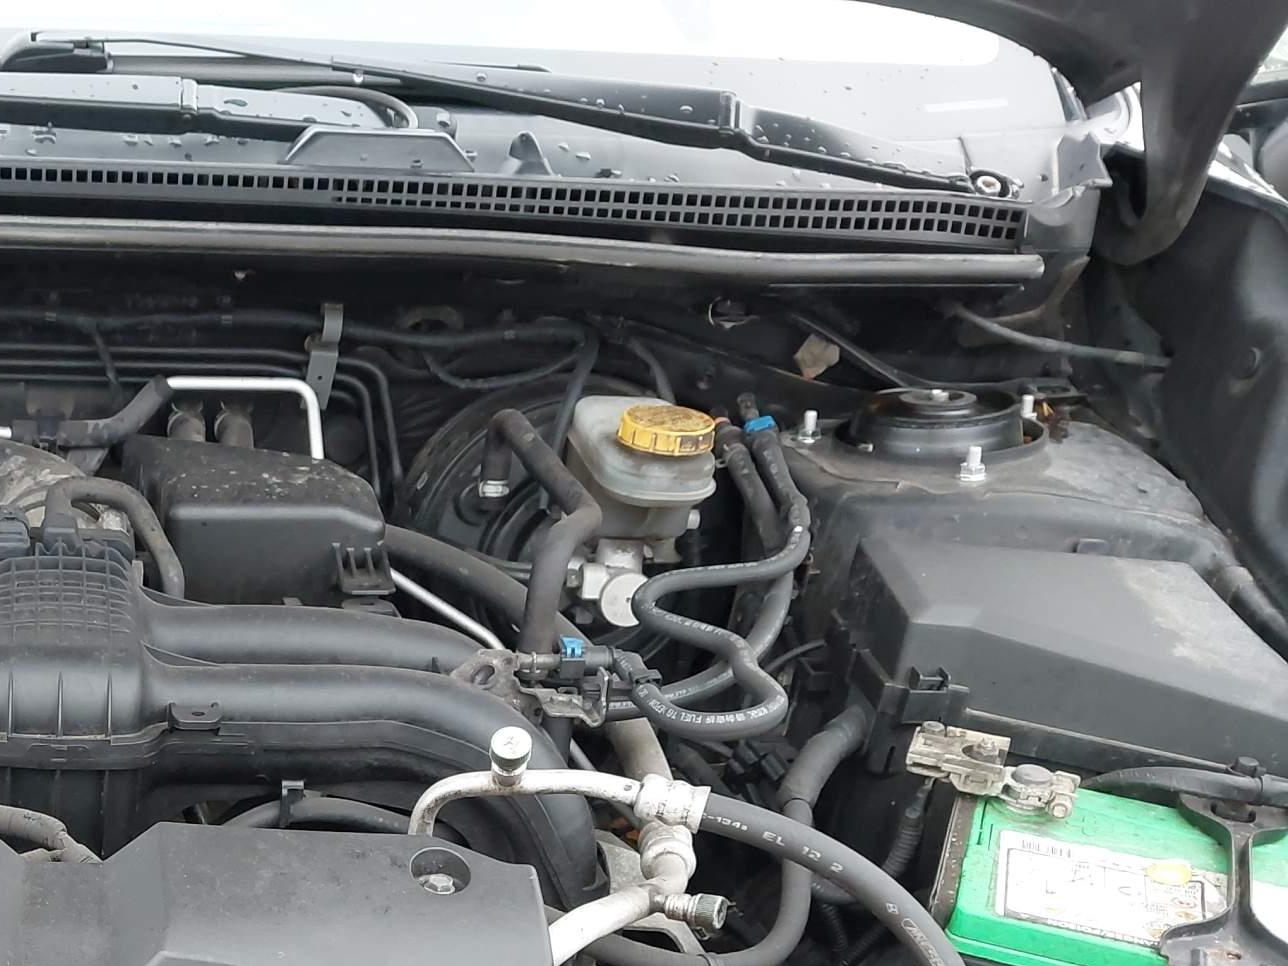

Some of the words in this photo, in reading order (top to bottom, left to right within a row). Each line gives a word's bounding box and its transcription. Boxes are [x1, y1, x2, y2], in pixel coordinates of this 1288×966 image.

[762, 831, 786, 847] EL
[802, 846, 822, 862] 12
[829, 862, 844, 874] 2
